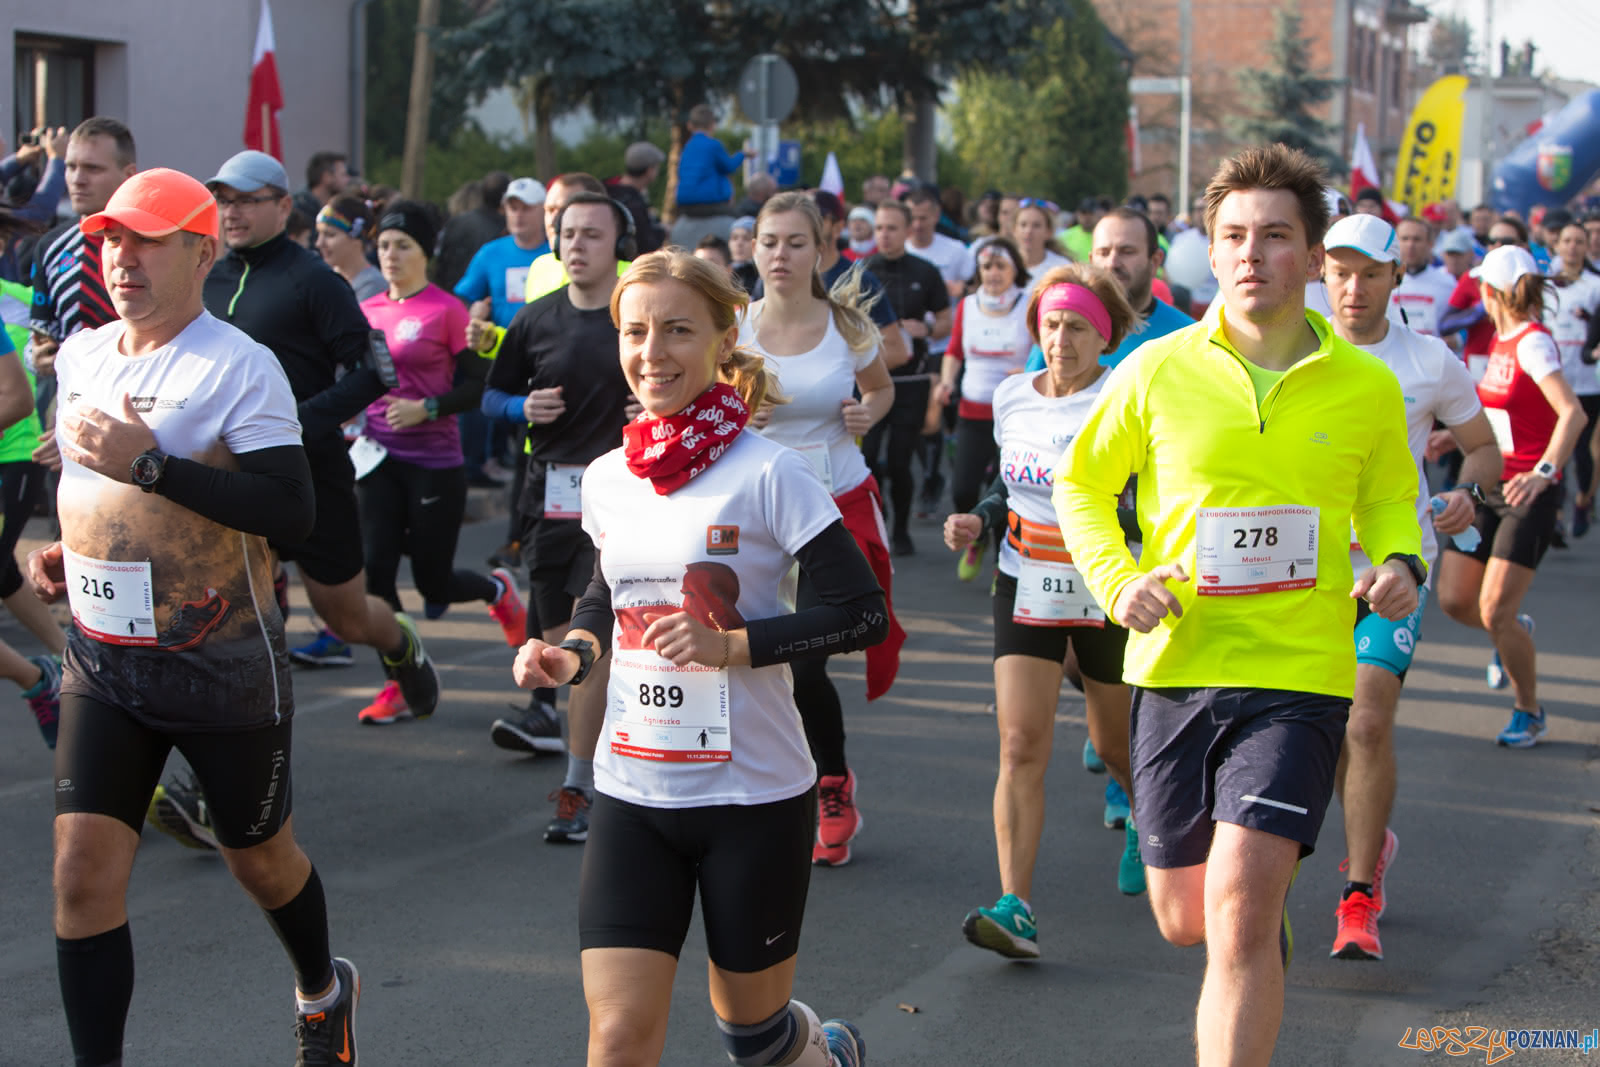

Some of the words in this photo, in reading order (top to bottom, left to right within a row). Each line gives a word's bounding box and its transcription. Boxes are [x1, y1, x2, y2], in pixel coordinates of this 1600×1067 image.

[696, 405, 724, 426] edp
[651, 421, 676, 440] edp
[1233, 526, 1278, 549] 278
[1242, 556, 1272, 564] Mateusz
[80, 575, 115, 600] 216
[1042, 577, 1076, 594] 811
[640, 683, 684, 708] 889
[643, 716, 681, 726] Agnieszka
[245, 749, 286, 836] Kalenji
